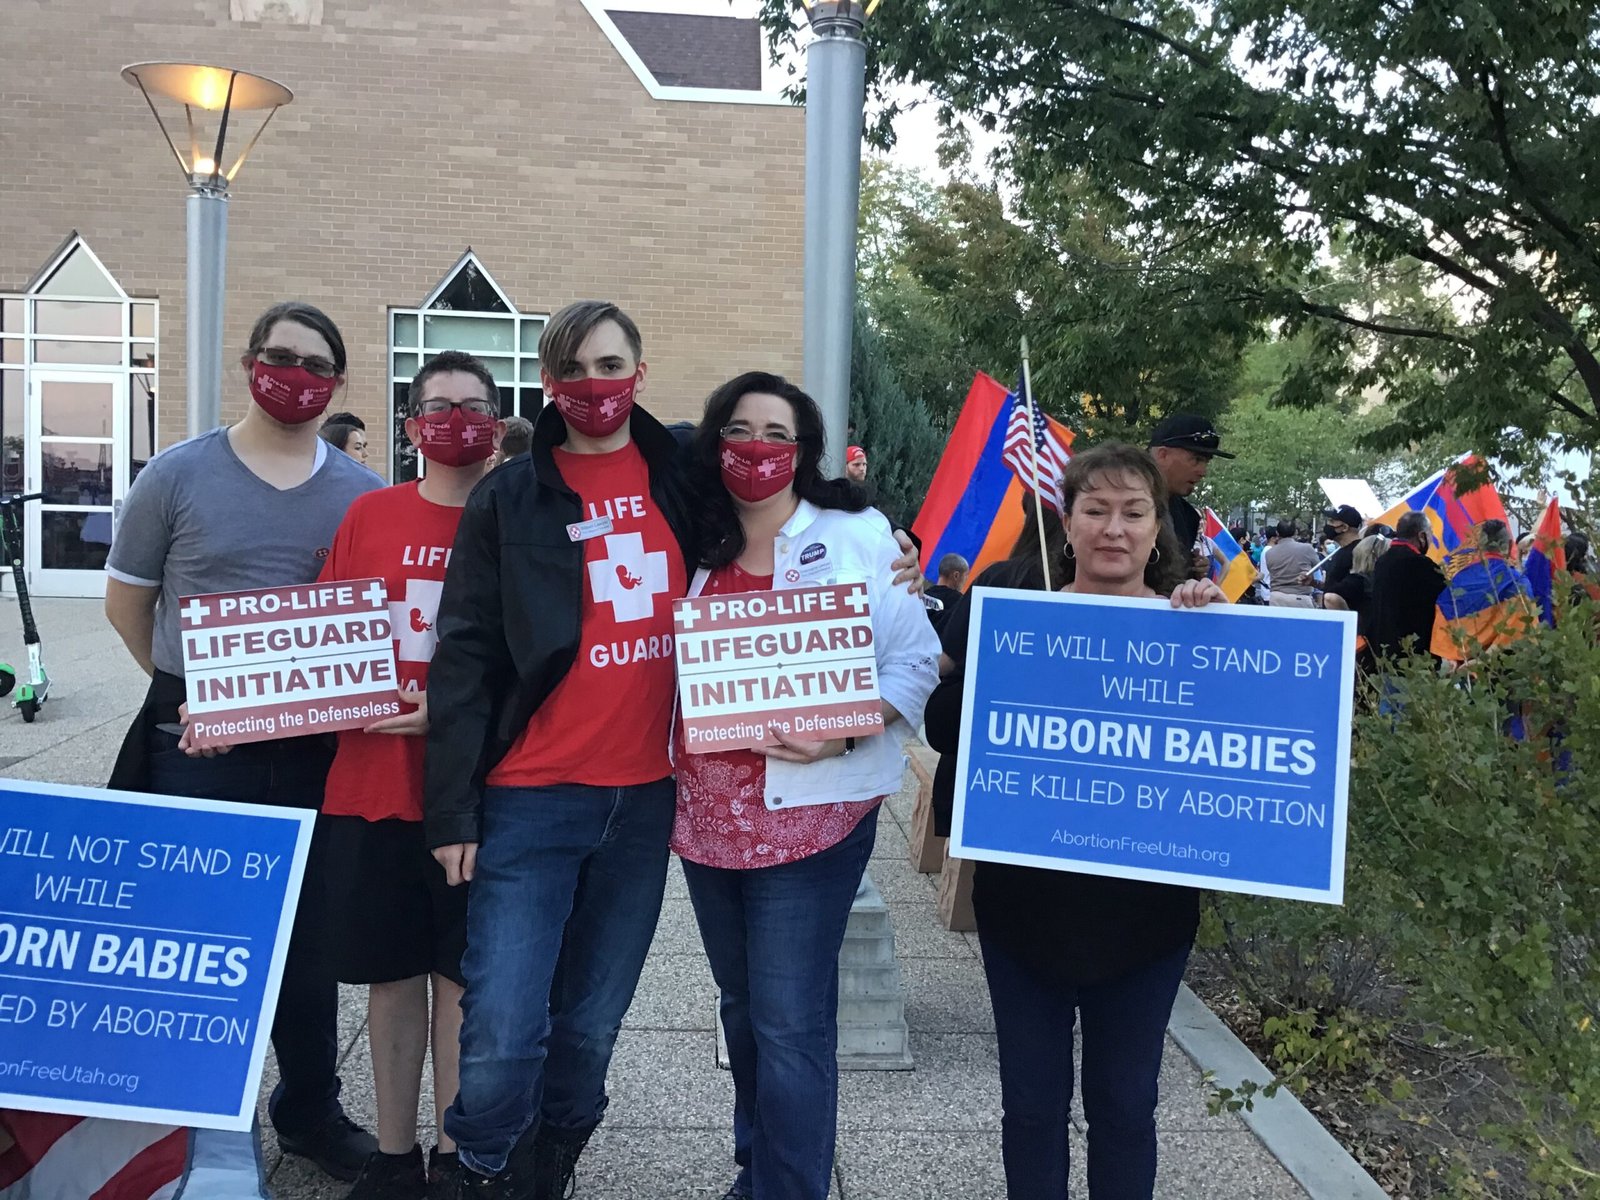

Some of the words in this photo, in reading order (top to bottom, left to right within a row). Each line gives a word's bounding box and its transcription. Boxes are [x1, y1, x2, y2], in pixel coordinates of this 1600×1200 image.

[589, 495, 647, 520] LIFE
[801, 548, 825, 561] TRUMP
[219, 586, 354, 618] PRO-LIFE
[709, 591, 837, 622] PRO-LIFE
[187, 618, 391, 661] LIFEGUARD
[590, 634, 673, 668] GUARD
[680, 624, 873, 665] LIFEGUARD
[994, 630, 1035, 655] WE
[1046, 633, 1115, 662] WILL
[1126, 640, 1181, 667] NOT
[1192, 645, 1281, 675] STAND
[1294, 652, 1330, 679] BY
[196, 658, 391, 703] INITIATIVE
[690, 667, 874, 707] INITIATIVE
[1101, 674, 1195, 706] WHILE
[194, 716, 275, 739] Protecting
[279, 708, 304, 727] the
[308, 701, 400, 725] Defenseless
[688, 722, 764, 744] Protecting
[795, 710, 883, 732] Defenseless
[988, 710, 1152, 760] UNBORN
[1164, 726, 1316, 776] BABIES
[970, 767, 1020, 795] ARE
[1032, 773, 1126, 806] KILLED
[1136, 785, 1170, 811] BY
[1178, 789, 1326, 829] ABORTION
[68, 834, 130, 866] NOT
[138, 842, 231, 875] STAND
[243, 852, 280, 881] BY
[1051, 828, 1230, 867] AbortionFreeUtah.org
[35, 873, 137, 909] WHILE
[88, 933, 251, 988] BABIES
[47, 1000, 87, 1029] BY
[92, 1004, 250, 1046] ABORTION
